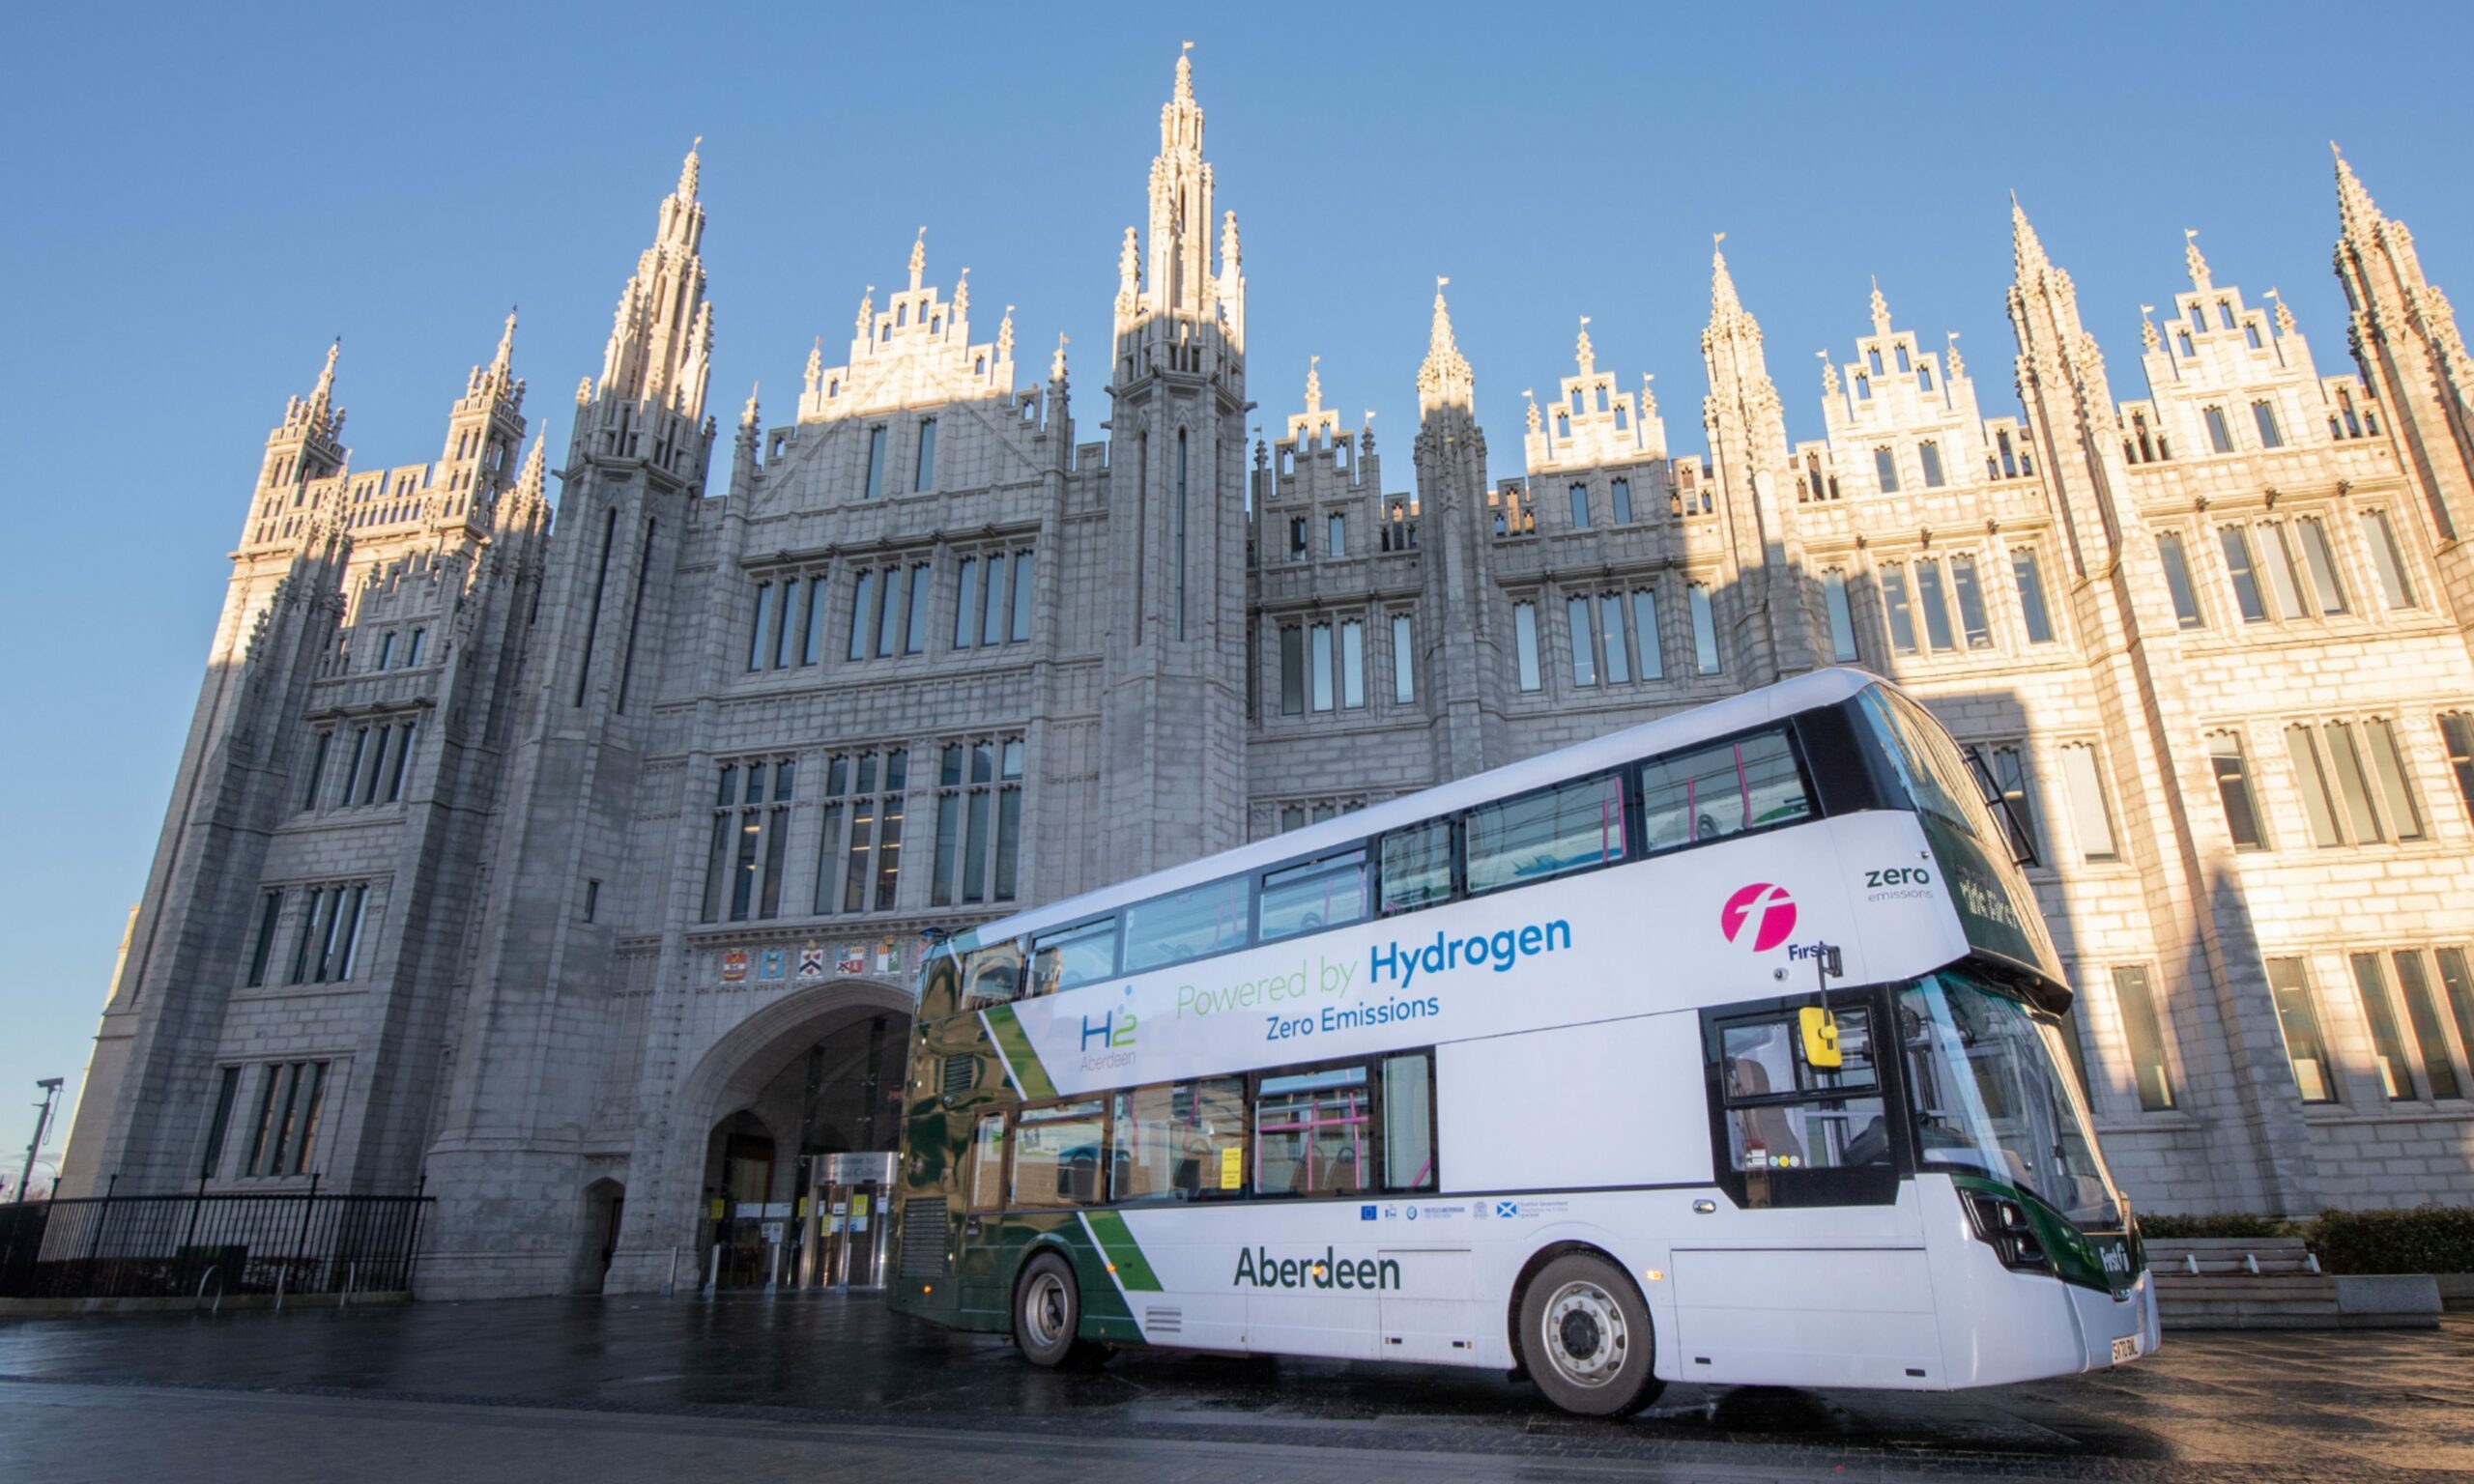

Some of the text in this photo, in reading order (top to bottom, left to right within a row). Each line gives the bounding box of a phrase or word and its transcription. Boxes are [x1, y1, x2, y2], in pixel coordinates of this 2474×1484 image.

[1865, 868, 1930, 888] zero
[1867, 888, 1933, 902] emissions
[1177, 918, 1571, 1019] Powered by Hydrogen
[1081, 1010, 1137, 1052] H2
[1266, 996, 1440, 1042] Zero Emissions
[1079, 1050, 1136, 1071] Aberdeen
[1233, 1245, 1400, 1290] Aberdeen
